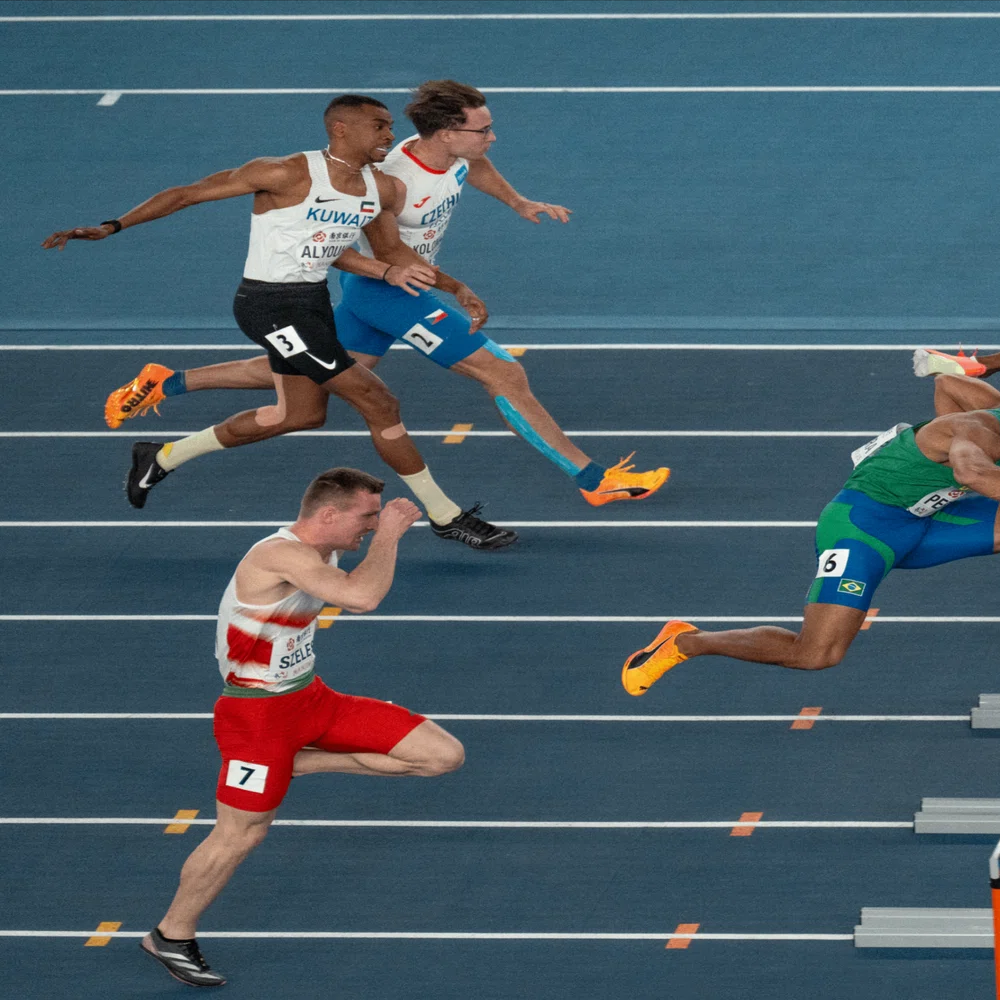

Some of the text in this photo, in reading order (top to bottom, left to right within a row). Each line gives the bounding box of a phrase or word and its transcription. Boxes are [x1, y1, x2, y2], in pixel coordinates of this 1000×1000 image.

[276, 334, 294, 352] 3
[411, 332, 434, 348] 2
[121, 379, 159, 413] NITRO
[823, 552, 837, 573] 6
[238, 766, 256, 786] 7
